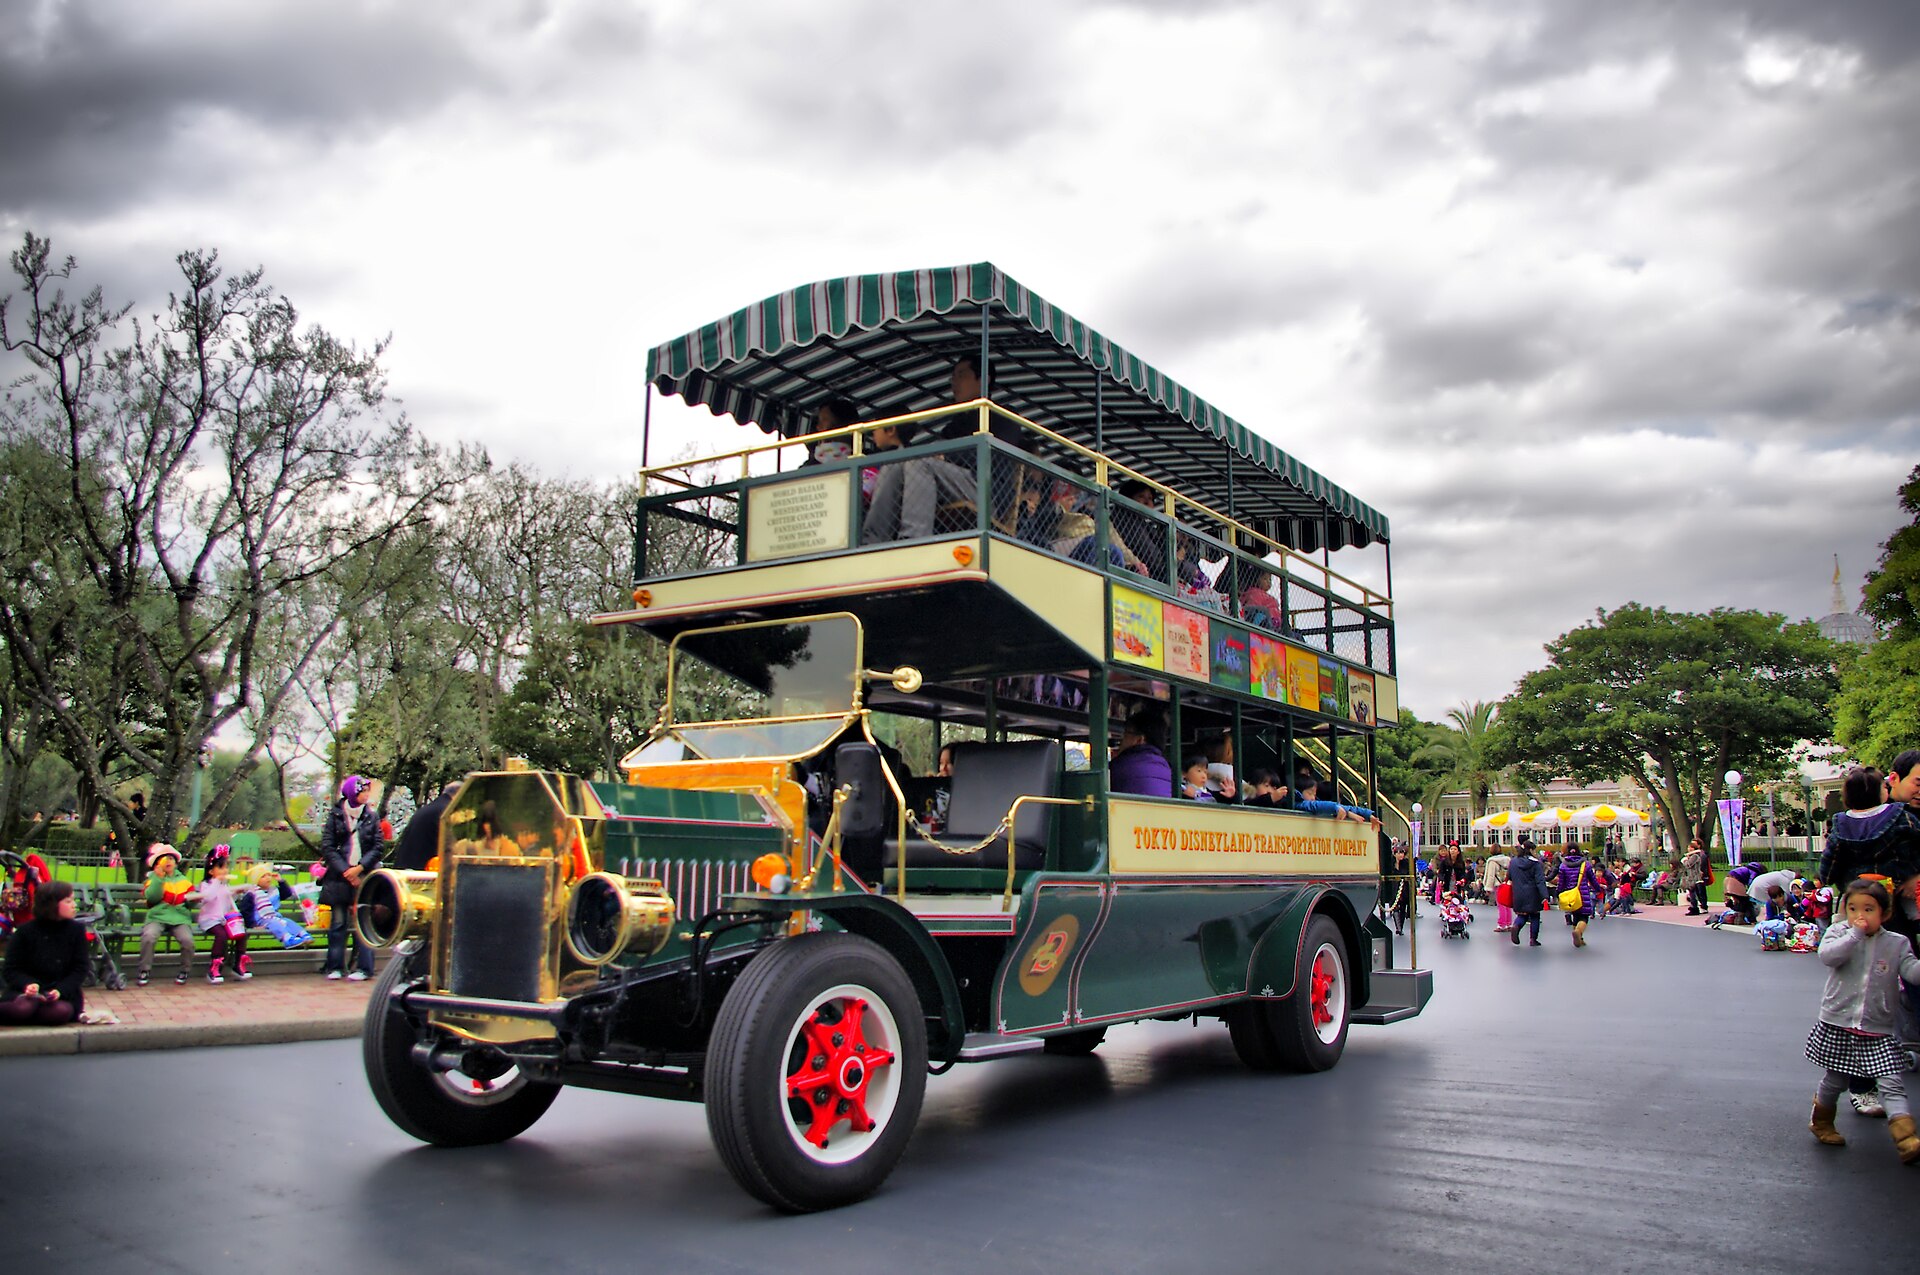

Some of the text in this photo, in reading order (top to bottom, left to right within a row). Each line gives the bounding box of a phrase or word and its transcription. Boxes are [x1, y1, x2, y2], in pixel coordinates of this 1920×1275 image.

[798, 483, 825, 494] BAZAAR
[770, 492, 828, 508] ADVENTURELAND
[773, 501, 824, 516] WESTERNLAND
[766, 510, 828, 526] CRITTER COUNTRY
[797, 530, 817, 540] TOWN
[1133, 826, 1367, 856] TOKYO DISNEYLAND TRANSPORTATION COMPANY
